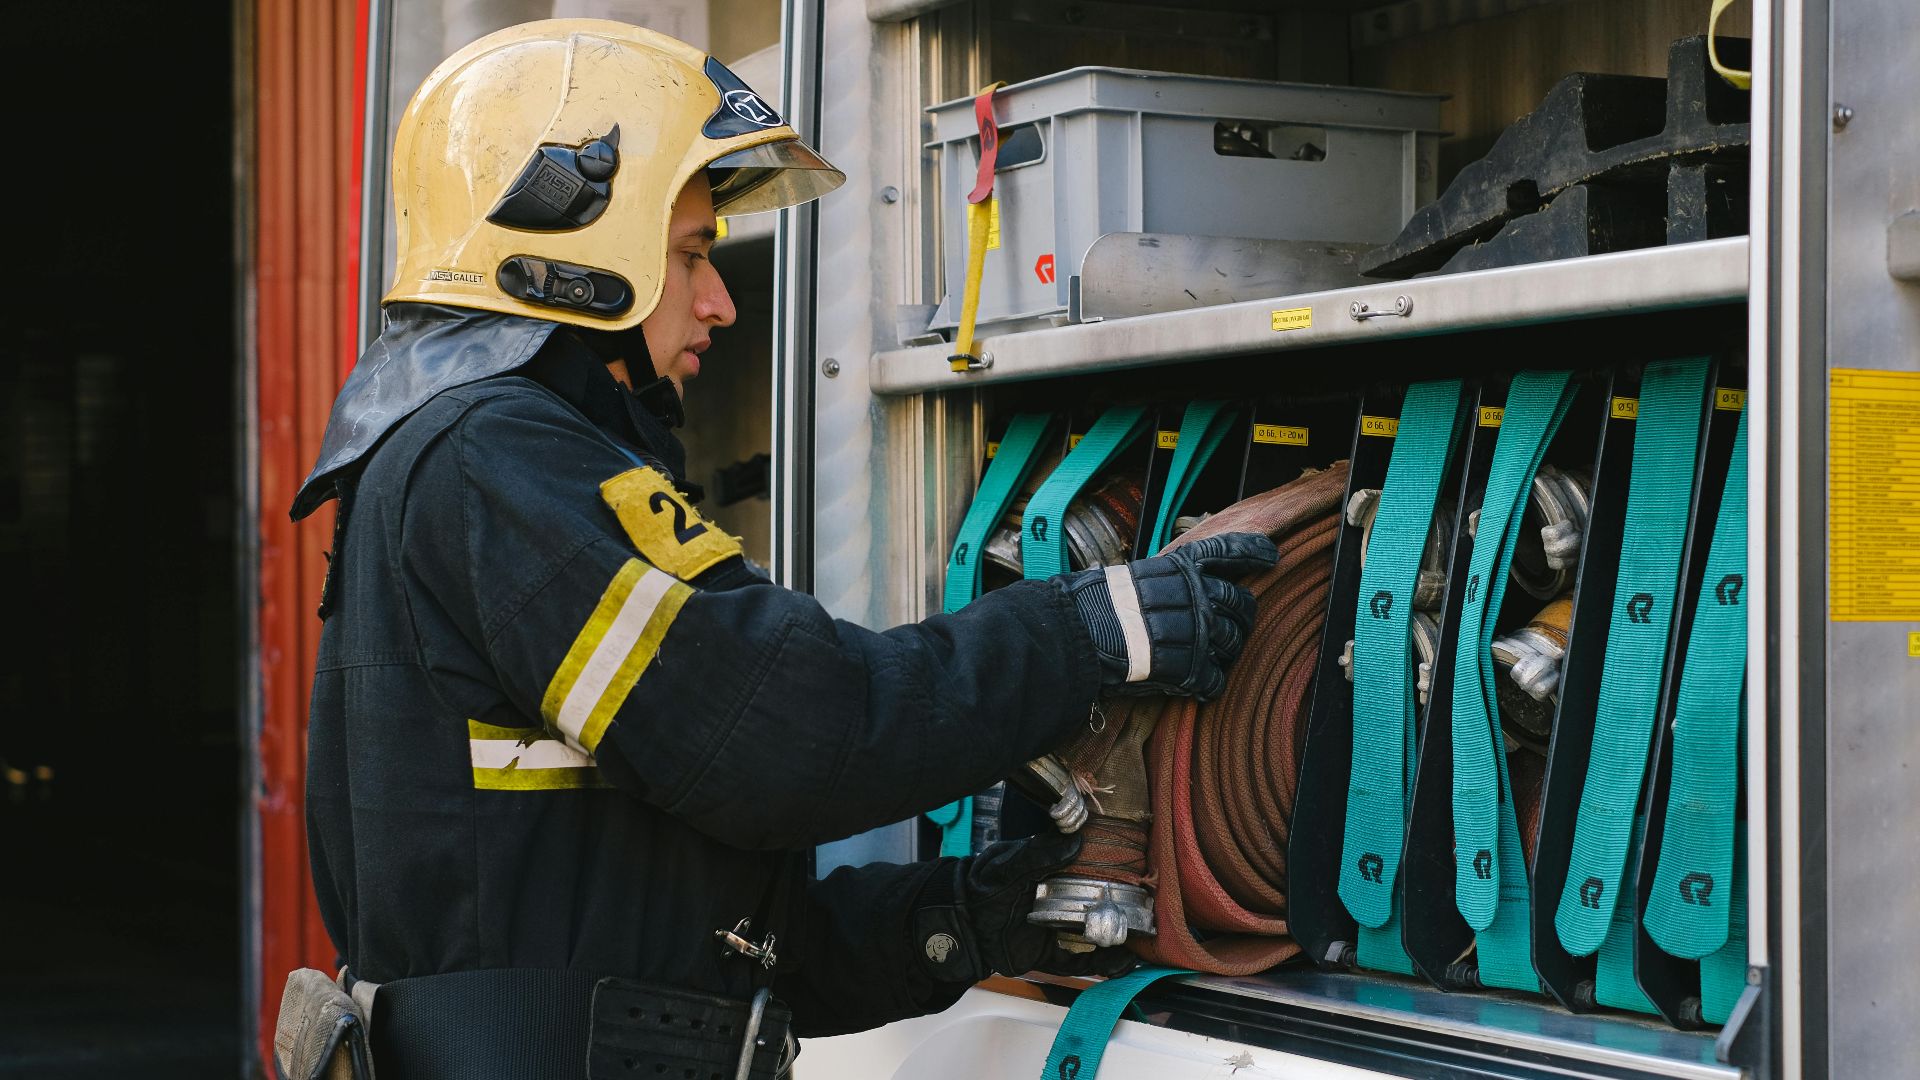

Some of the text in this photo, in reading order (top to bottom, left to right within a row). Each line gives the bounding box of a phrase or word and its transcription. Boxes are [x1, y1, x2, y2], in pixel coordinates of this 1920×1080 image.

[734, 94, 772, 122] 27
[538, 169, 574, 198] MSA
[431, 270, 484, 283] MSA GALLET
[649, 491, 709, 546] 2
